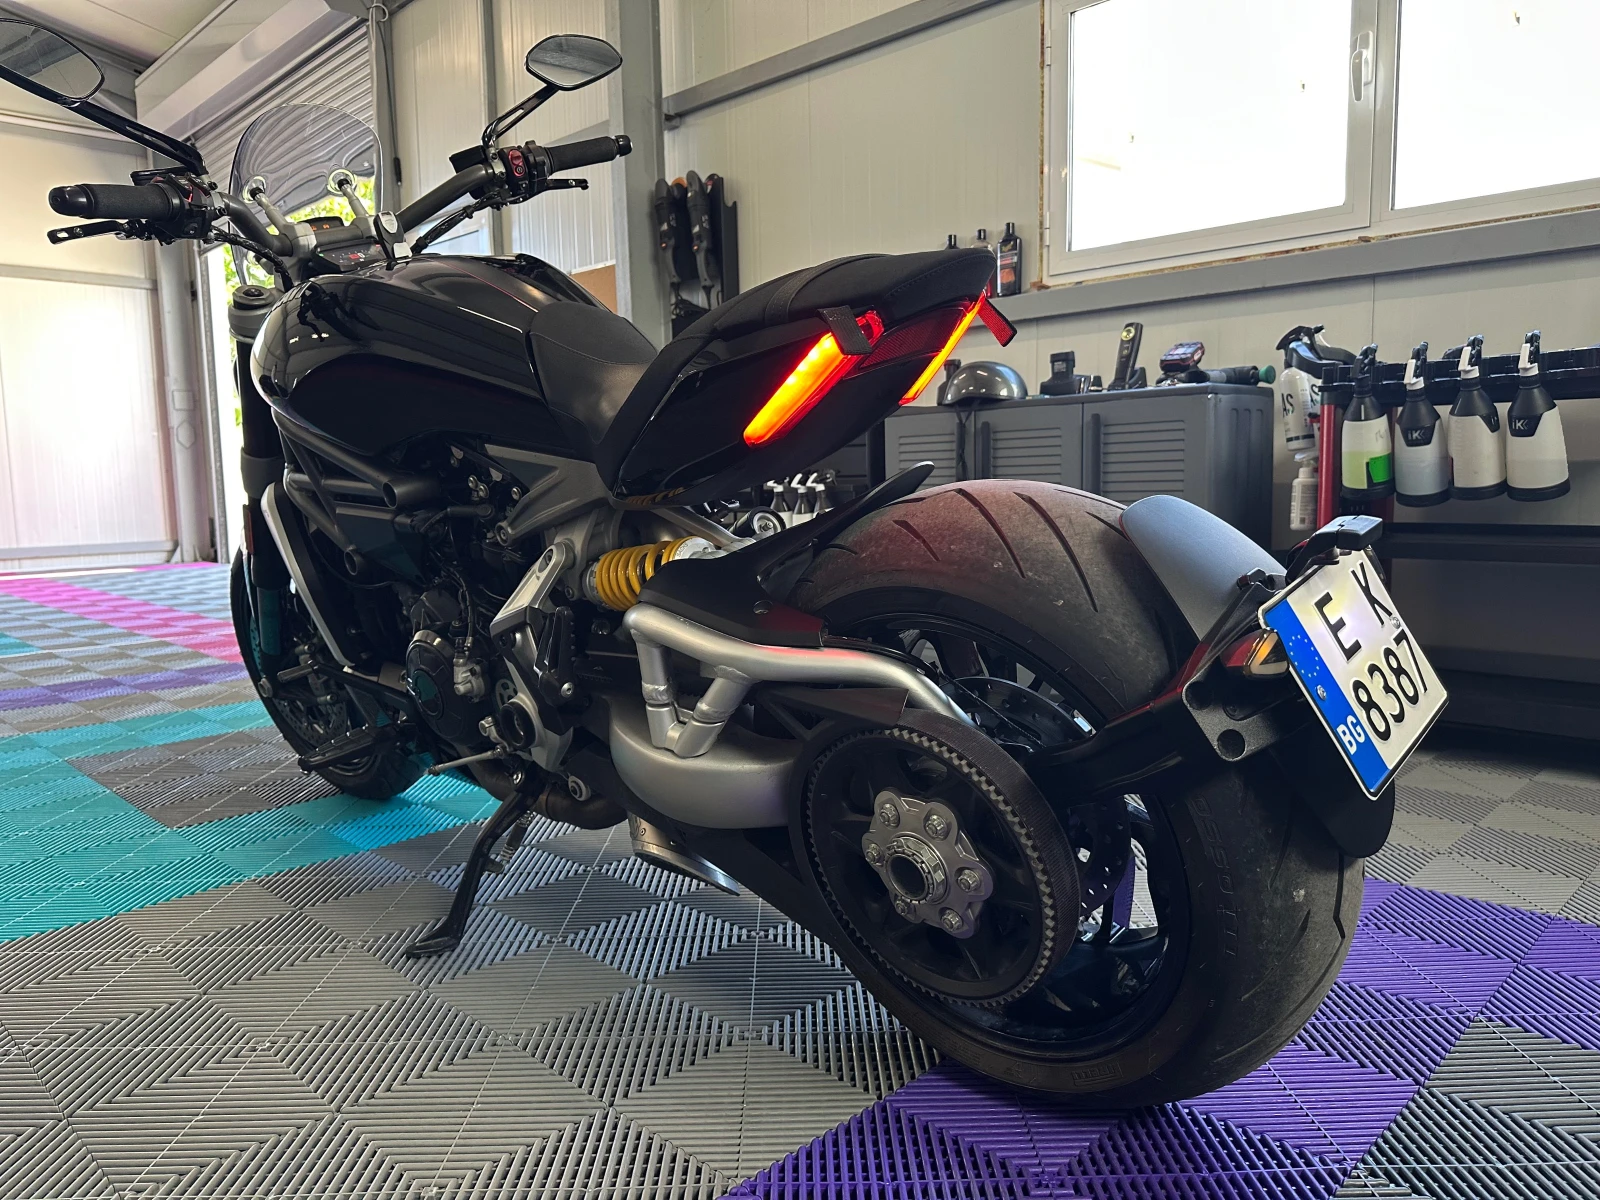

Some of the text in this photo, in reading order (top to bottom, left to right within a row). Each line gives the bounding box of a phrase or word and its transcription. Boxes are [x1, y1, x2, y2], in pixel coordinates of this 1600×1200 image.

[1314, 561, 1393, 661] E K
[1337, 715, 1365, 755] BG
[1352, 634, 1428, 742] 8387
